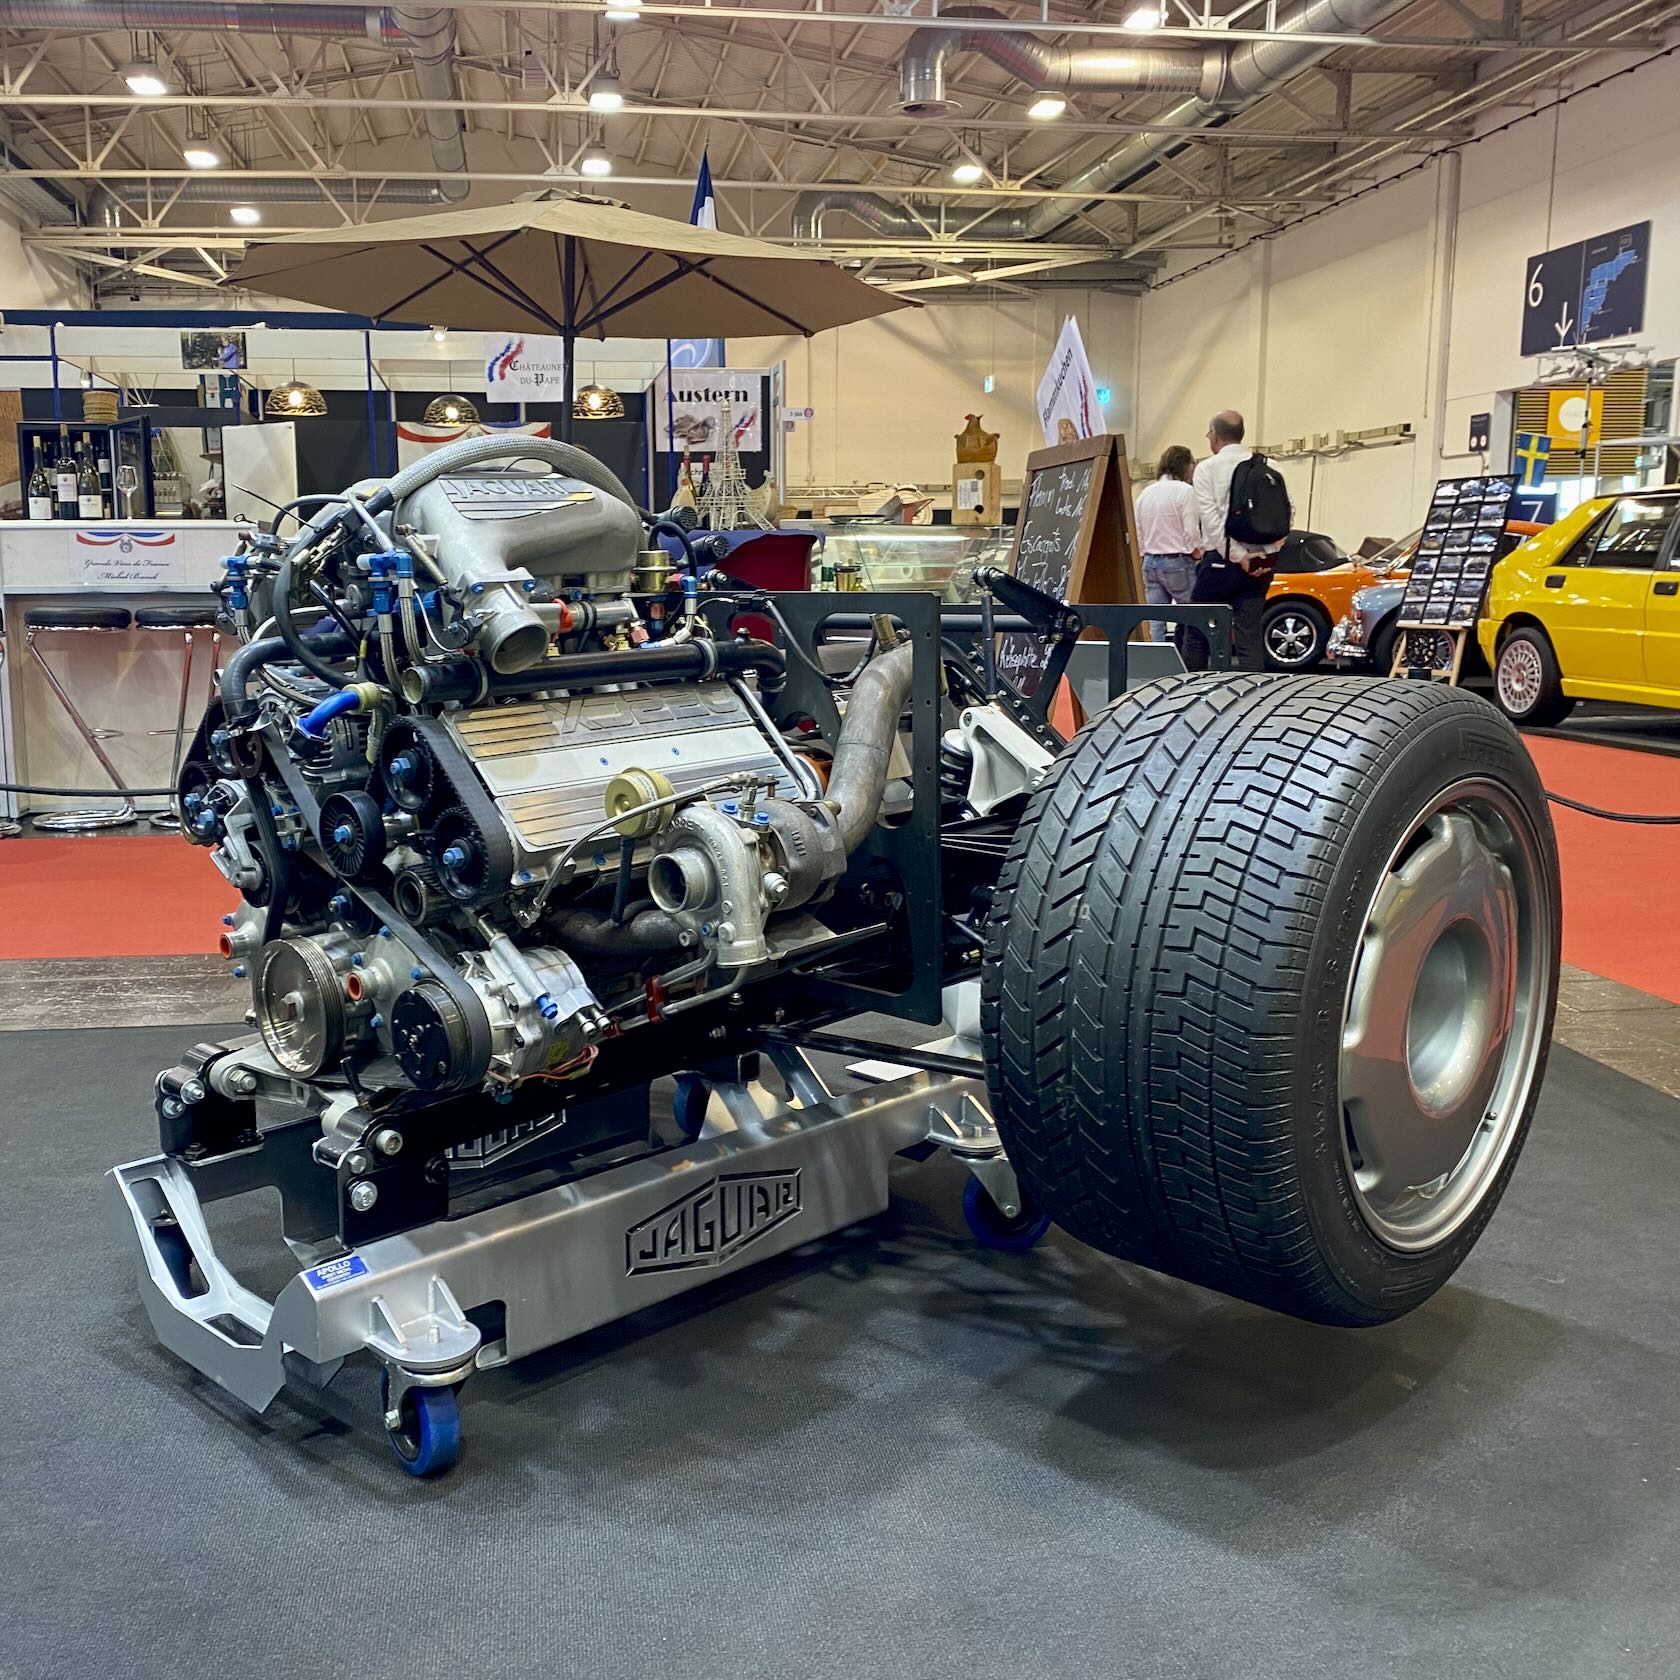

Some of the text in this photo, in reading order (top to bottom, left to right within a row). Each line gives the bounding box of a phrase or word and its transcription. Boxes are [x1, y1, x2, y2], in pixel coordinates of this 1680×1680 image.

[1528, 263, 1544, 307] 6
[662, 387, 748, 403] Austern
[447, 479, 569, 499] JAGUAR
[1521, 500, 1543, 522] 7
[639, 1182, 797, 1260] JAGUAR
[316, 1260, 351, 1277] APOLLO
